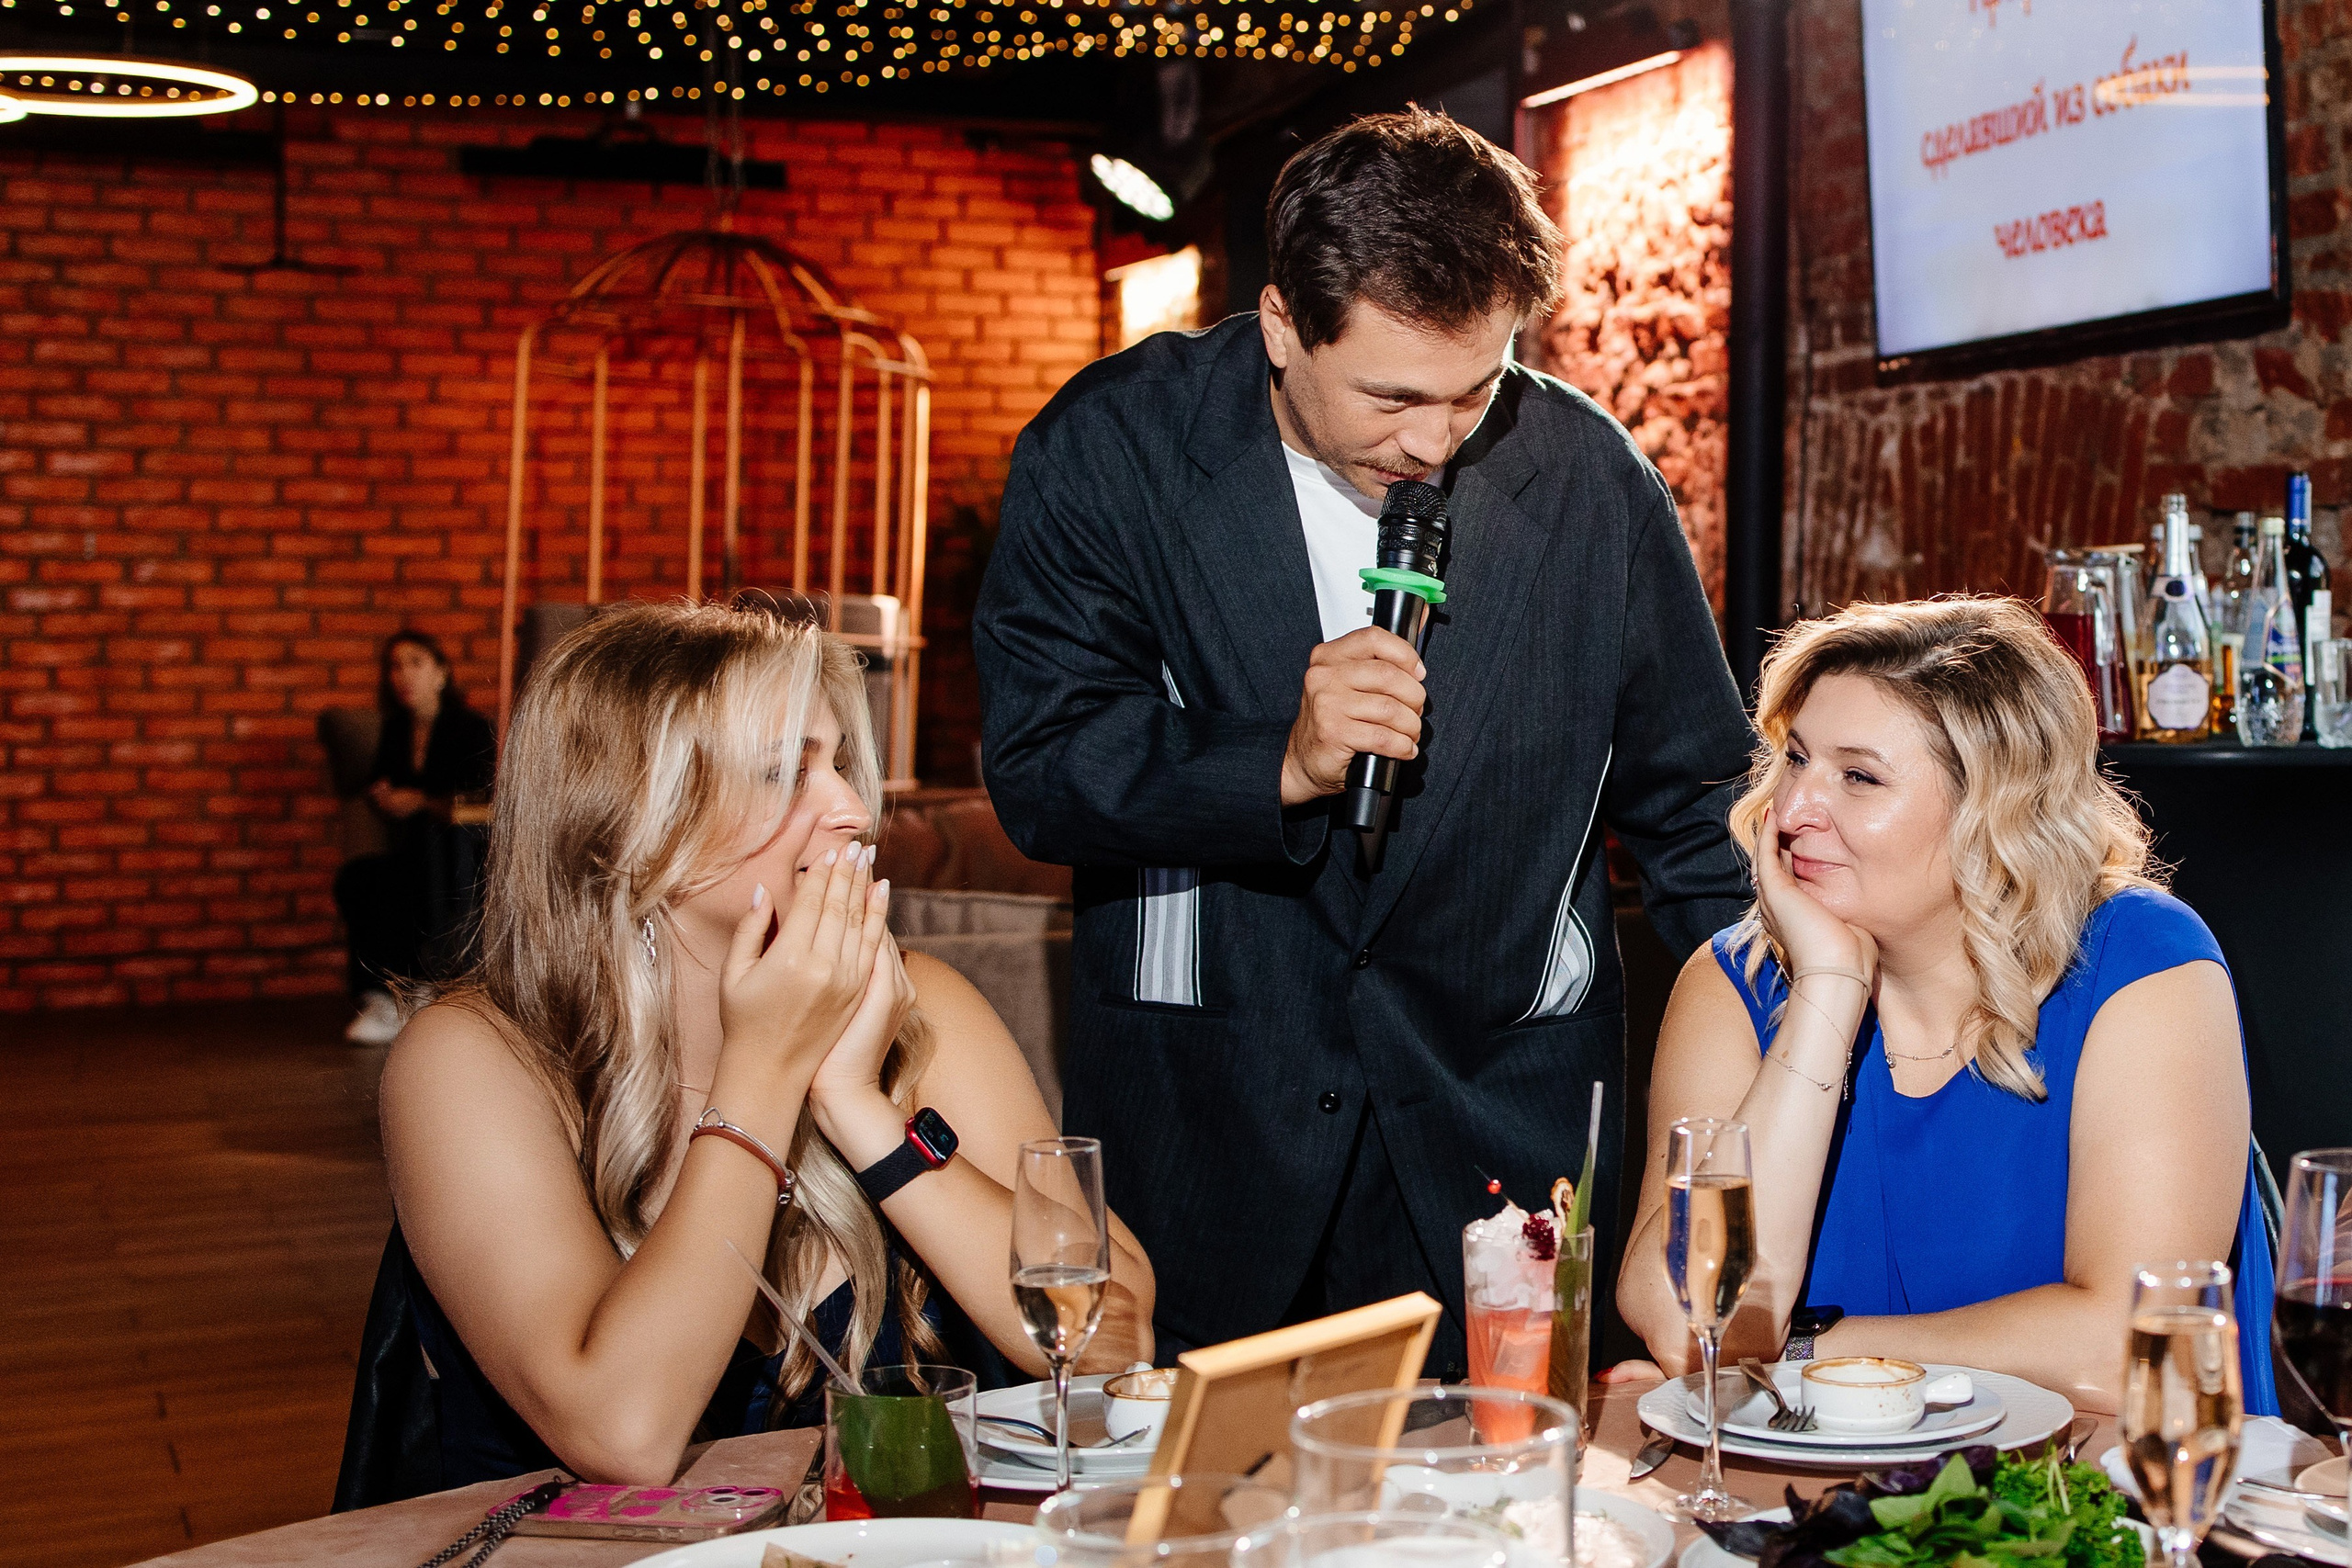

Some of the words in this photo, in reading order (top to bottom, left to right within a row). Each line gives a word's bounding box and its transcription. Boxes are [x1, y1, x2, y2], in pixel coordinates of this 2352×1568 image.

[2052, 84, 2086, 127] из
[2092, 34, 2189, 117] собаки
[1994, 199, 2107, 258] человека
